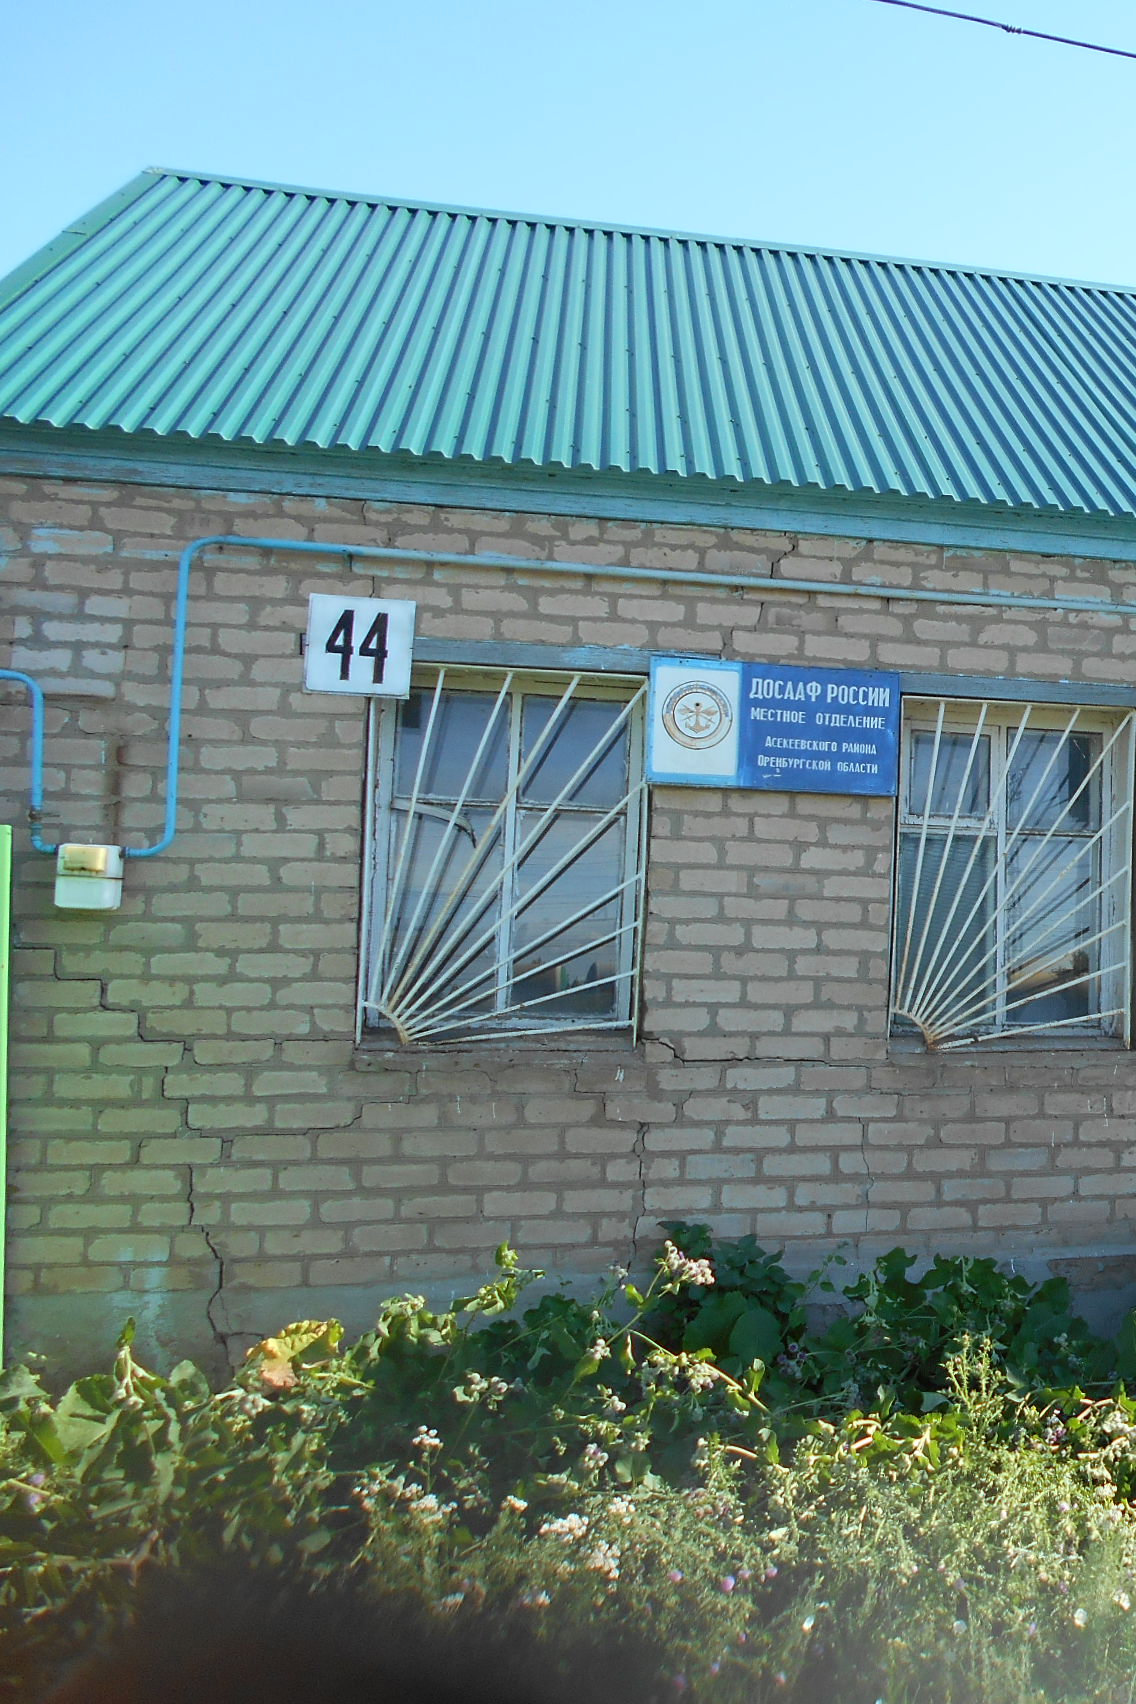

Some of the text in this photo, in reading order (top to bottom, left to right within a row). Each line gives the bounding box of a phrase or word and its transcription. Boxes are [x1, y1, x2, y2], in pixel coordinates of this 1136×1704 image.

[325, 609, 389, 684] 44
[750, 678, 822, 702] ДОСААФ
[827, 684, 890, 707] РОССИИ
[750, 707, 886, 730] МЕСТНОЕ ОТДЕЛЕНИЕ
[837, 762, 878, 774] ОБЛАСТИ
